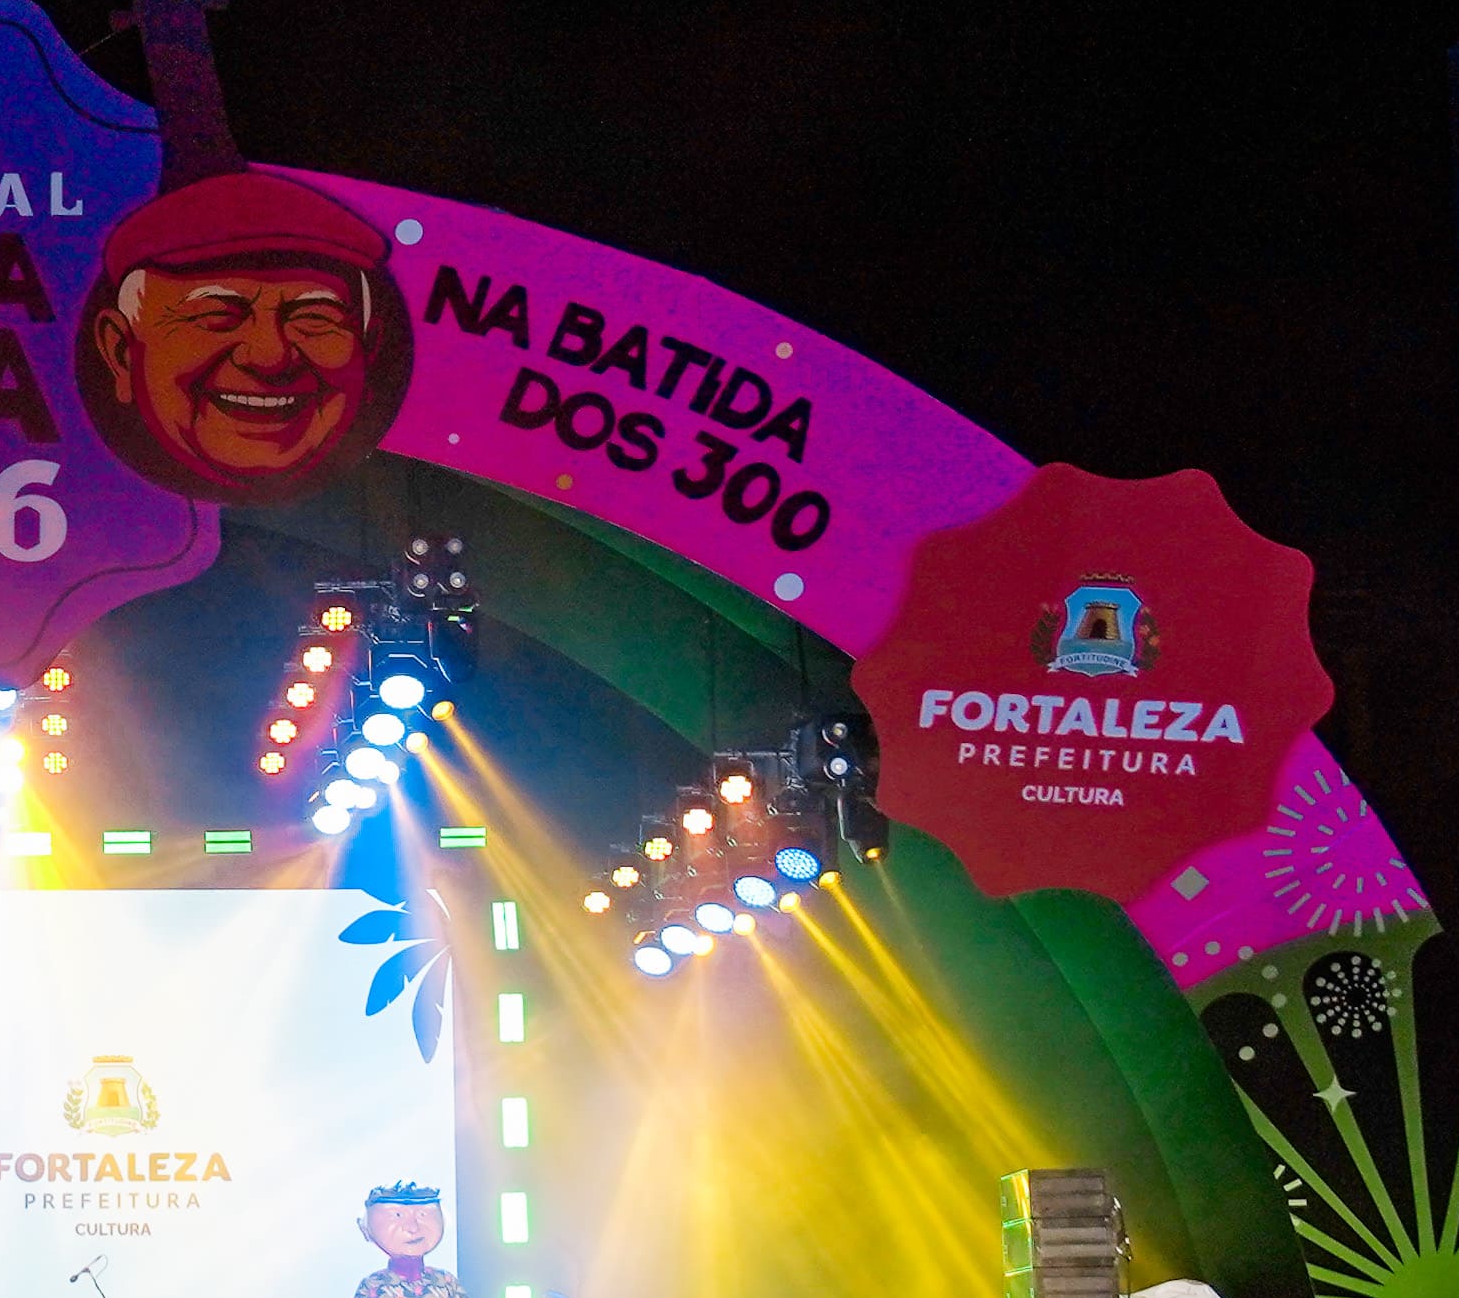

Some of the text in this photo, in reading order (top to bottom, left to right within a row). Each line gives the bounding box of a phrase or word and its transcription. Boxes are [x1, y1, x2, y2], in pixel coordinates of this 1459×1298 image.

[423, 264, 812, 464] NA BATIDA
[499, 366, 831, 552] DOS 300
[918, 689, 1244, 744] FORTALEZA
[958, 742, 1196, 776] PREFEITURA
[1022, 785, 1124, 806] CULTURA
[24, 1192, 201, 1210] PREFEITURA
[75, 1222, 152, 1236] CULTURA
